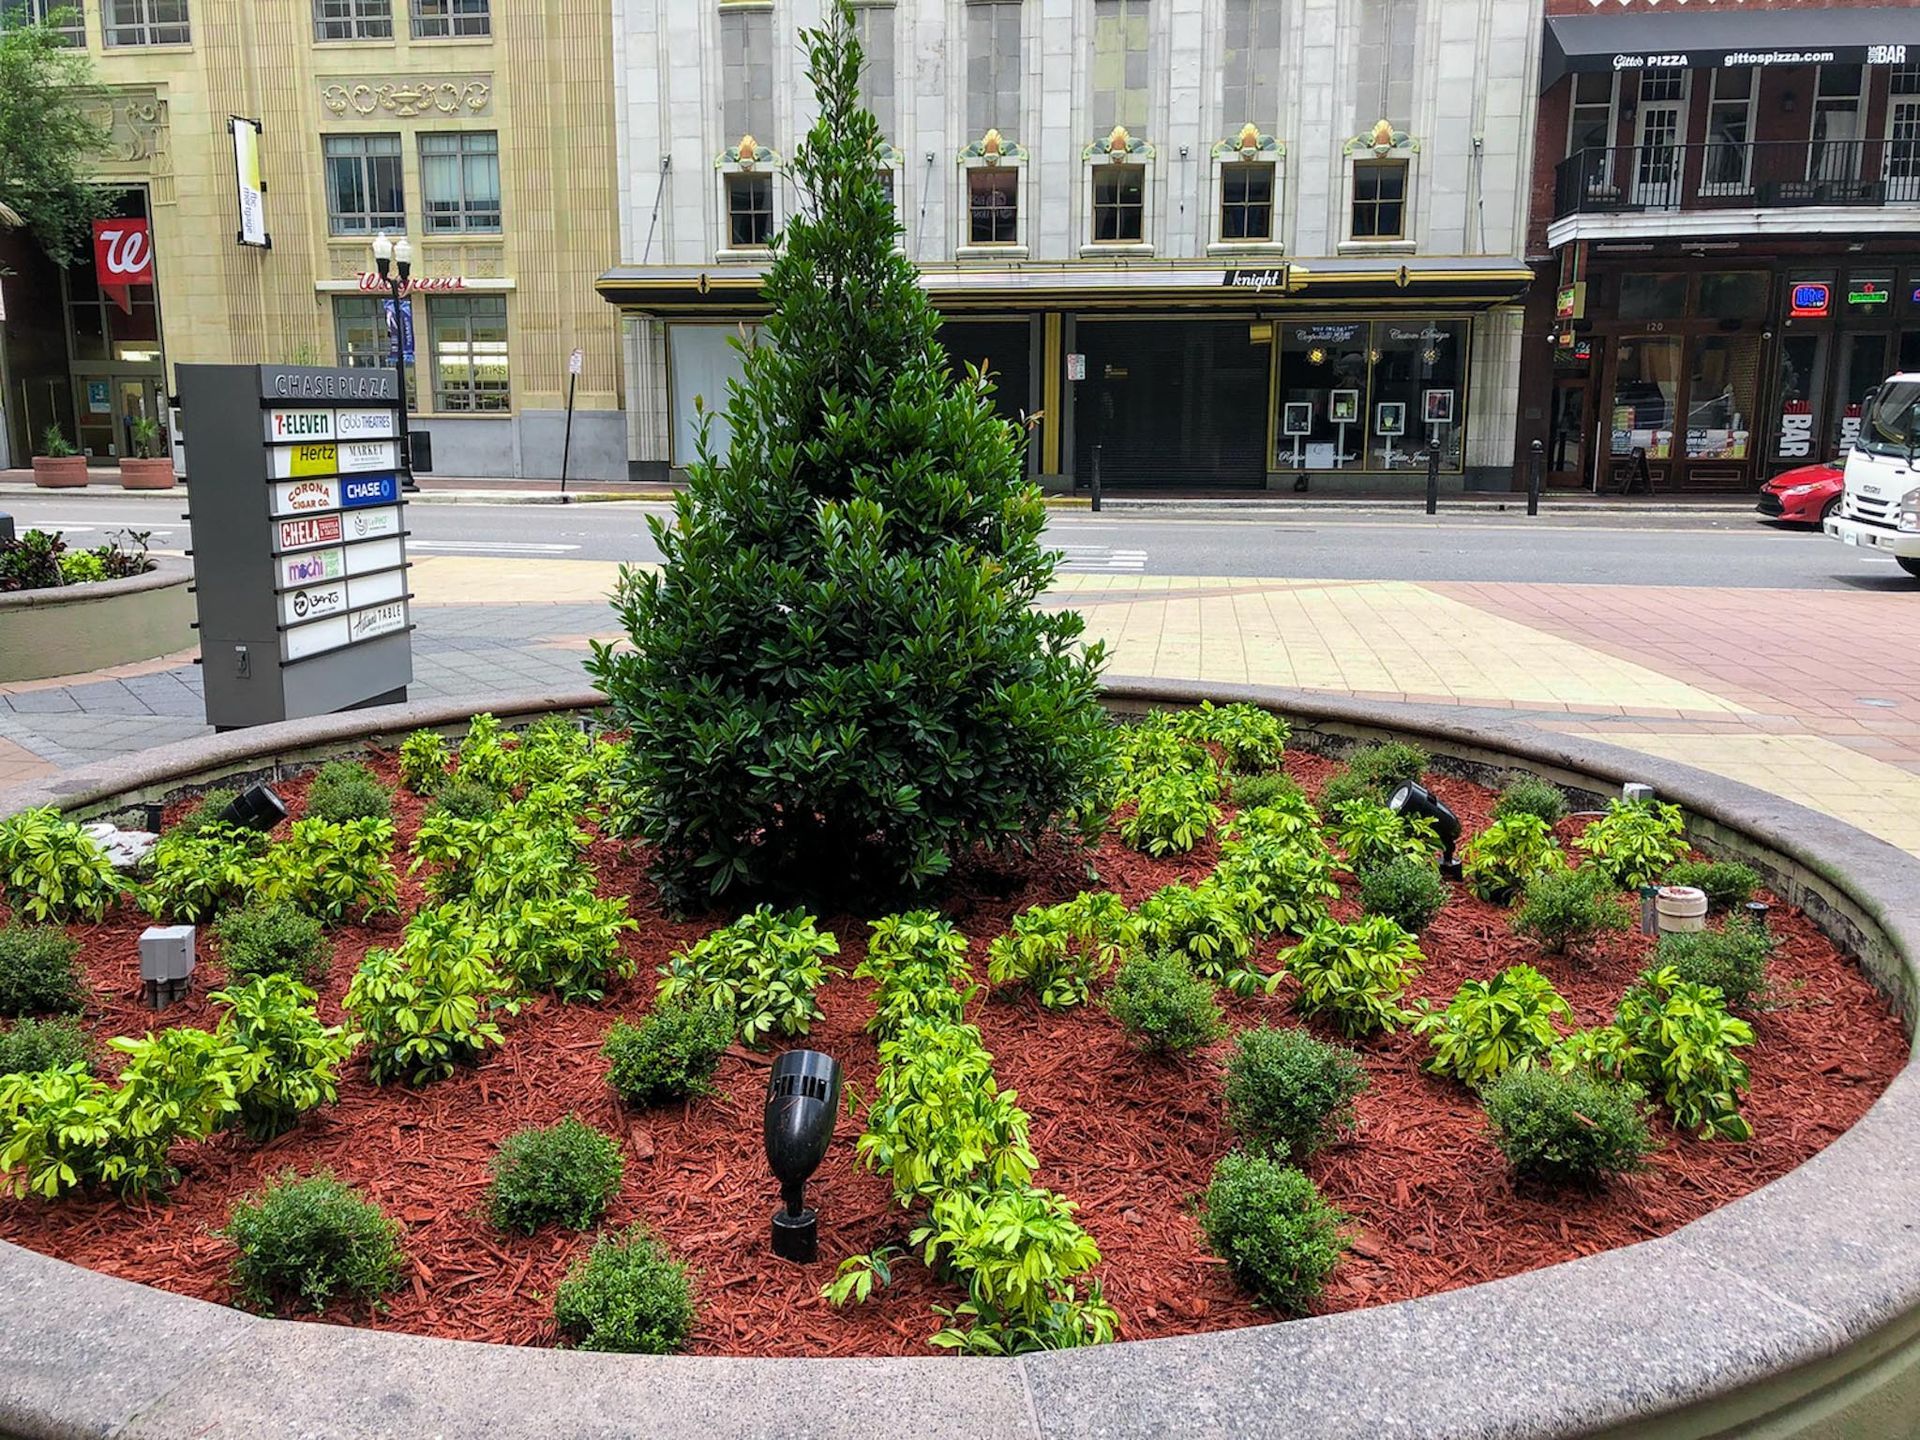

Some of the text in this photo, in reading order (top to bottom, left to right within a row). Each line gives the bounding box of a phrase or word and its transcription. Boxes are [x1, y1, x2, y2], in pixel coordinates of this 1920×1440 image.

[1647, 55, 1688, 67] PIZZA
[1723, 51, 1834, 67] gittospizza.com
[1877, 45, 1906, 64] BAR
[356, 272, 467, 298] Wagreens
[1231, 269, 1280, 293] knight
[1389, 328, 1451, 342] Custom Design
[1646, 322, 1664, 332] 120
[275, 374, 391, 398] CHASE PLAZA
[338, 413, 390, 434] Cobb THEATRES
[1779, 414, 1813, 457] BAR
[300, 446, 334, 461] Hertz
[348, 444, 383, 457] MARKET
[287, 482, 330, 502] CORONA
[346, 481, 381, 499] CHASE
[292, 499, 316, 510] CIGAR
[282, 519, 320, 548] CHELA
[377, 604, 401, 621] TABLE
